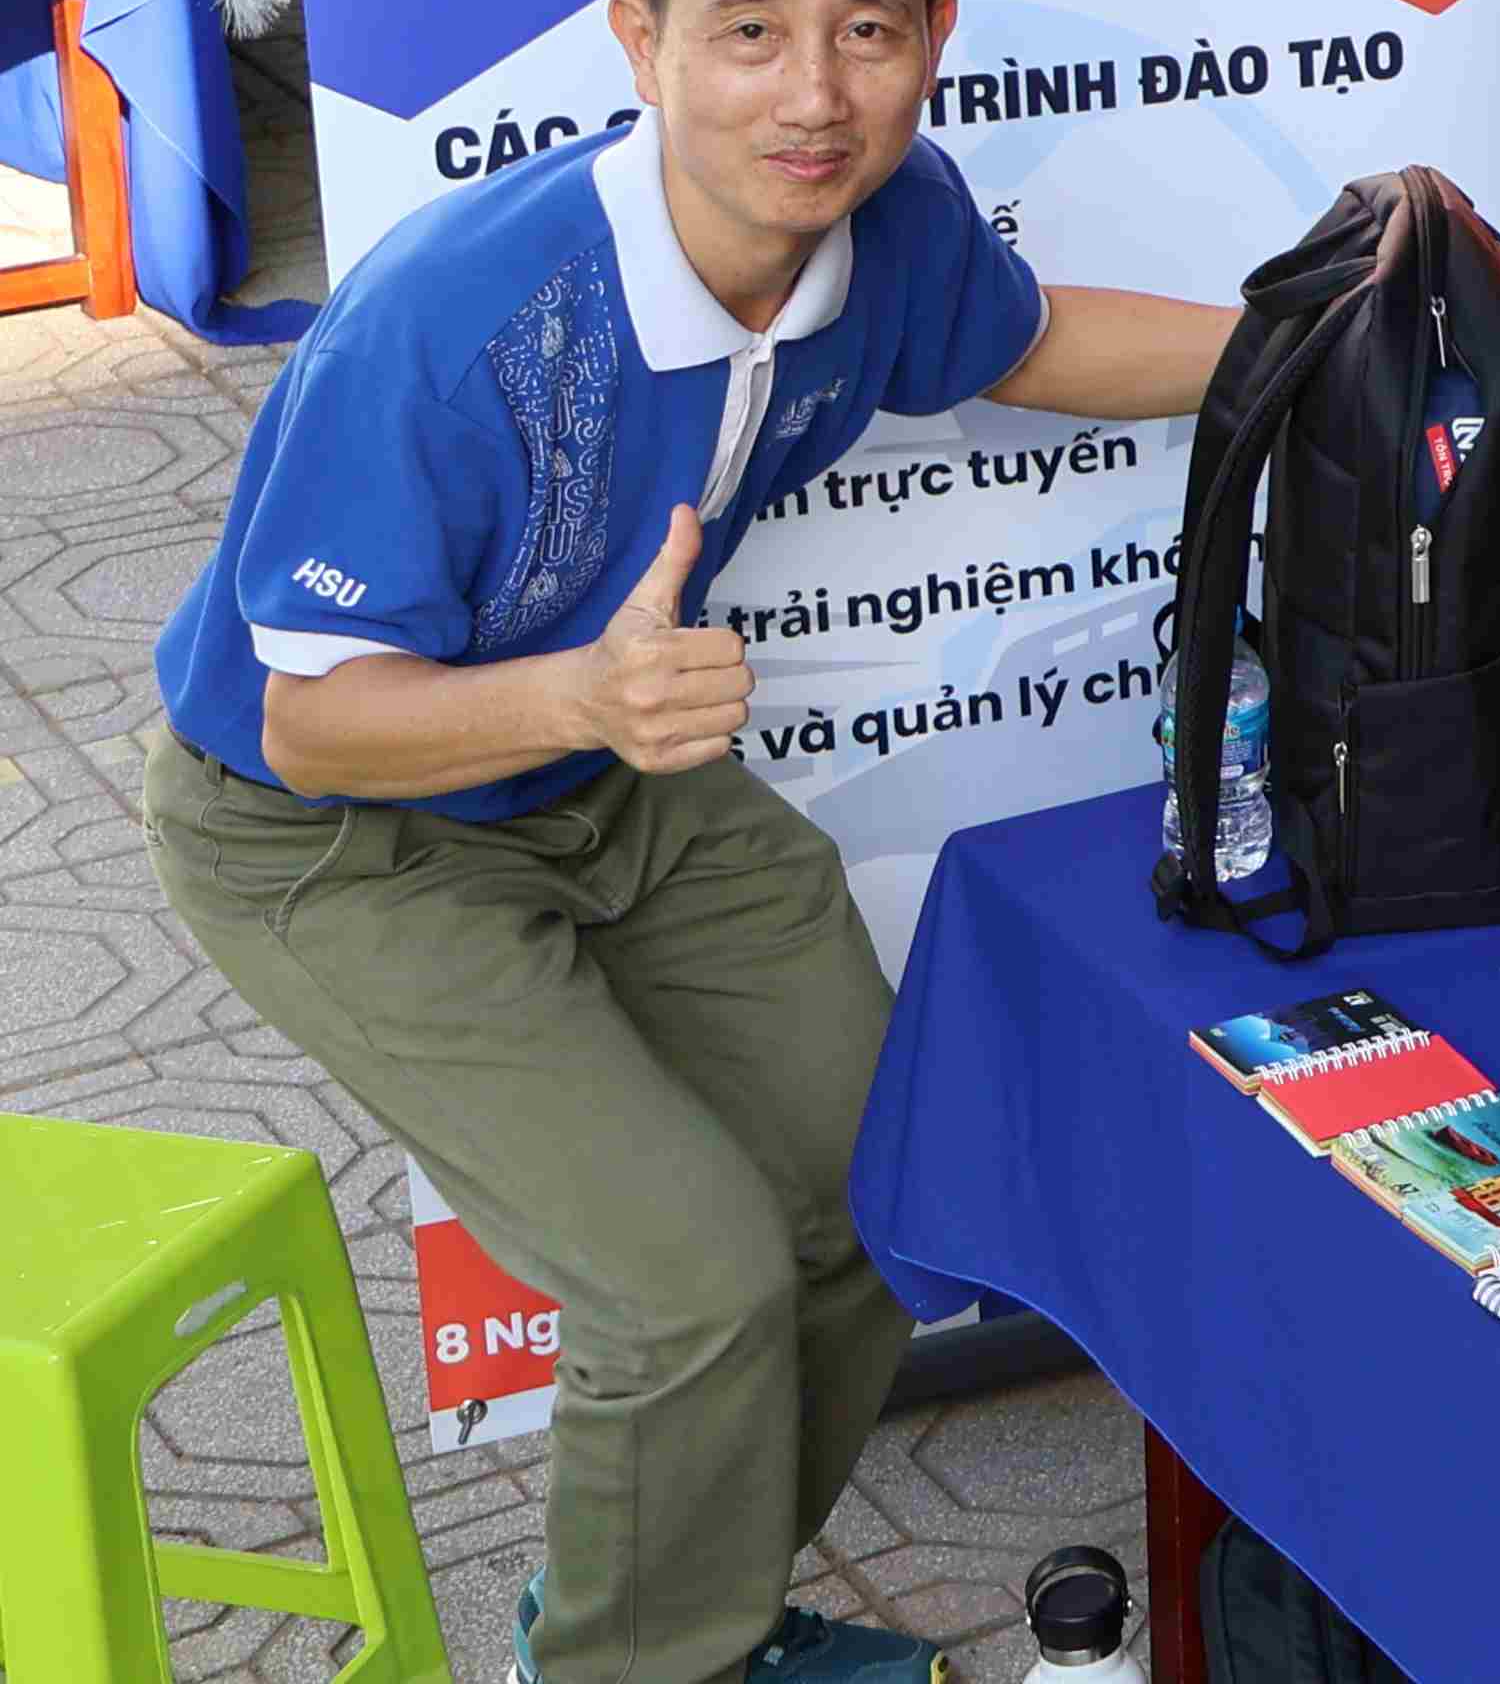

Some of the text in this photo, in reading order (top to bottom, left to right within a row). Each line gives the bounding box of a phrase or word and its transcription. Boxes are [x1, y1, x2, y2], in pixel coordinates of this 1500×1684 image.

[930, 46, 1116, 129] TRÌNH
[1138, 32, 1267, 106] ĐÀO
[1286, 30, 1404, 104] TẠO
[824, 459, 953, 517] trực
[967, 424, 1138, 498] tuyến
[292, 557, 369, 608] HSU
[734, 562, 1076, 647] trải nghiệm
[761, 704, 837, 761] và
[852, 682, 1001, 758] quản
[1019, 664, 1071, 727] lý
[435, 1322, 469, 1365] 8
